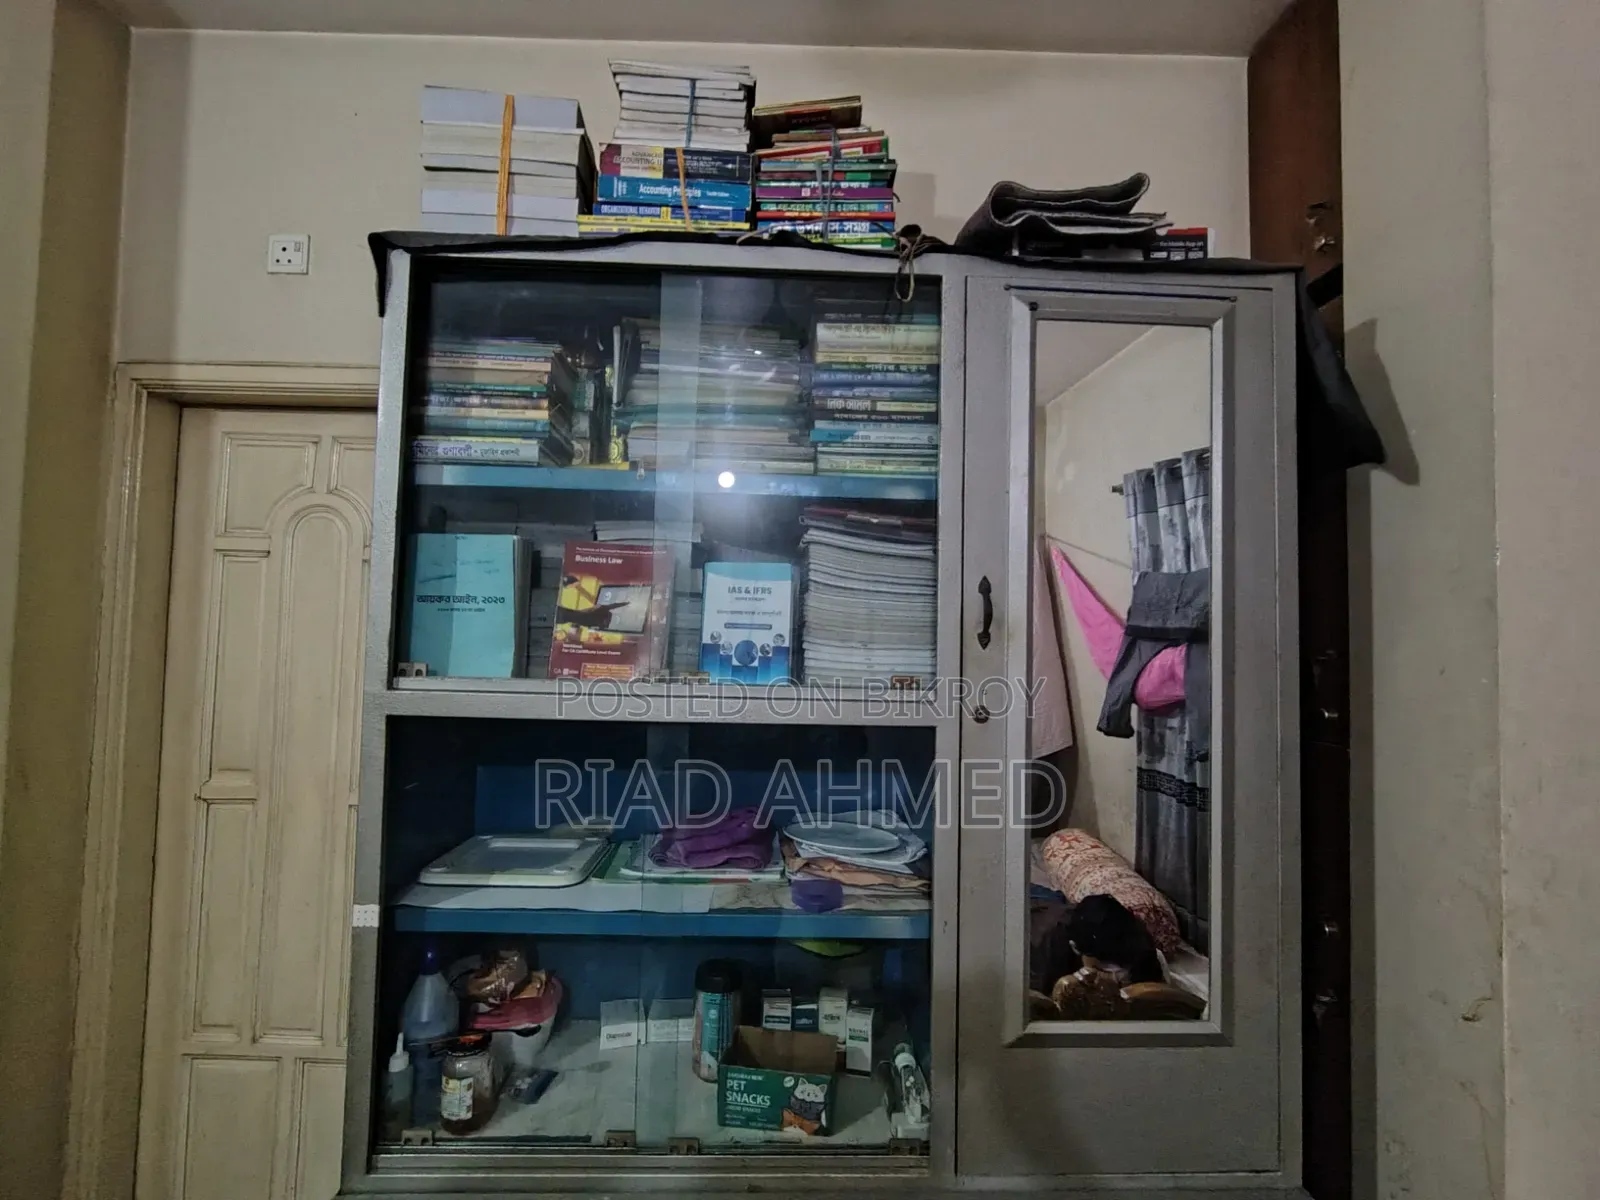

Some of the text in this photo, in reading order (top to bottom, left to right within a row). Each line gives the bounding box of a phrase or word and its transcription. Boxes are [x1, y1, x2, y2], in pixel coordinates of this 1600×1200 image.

[639, 183, 672, 197] Accounting
[673, 185, 701, 198] Priciples
[600, 204, 660, 216] ORGANIZATIONAL BEHAVIOR
[575, 554, 624, 565] Business Law
[728, 585, 773, 595] IAS & IFRS
[416, 593, 506, 606] আয়কর আইন, ২০২৩
[726, 1080, 746, 1091] PET
[726, 1091, 771, 1106] SNACKS
